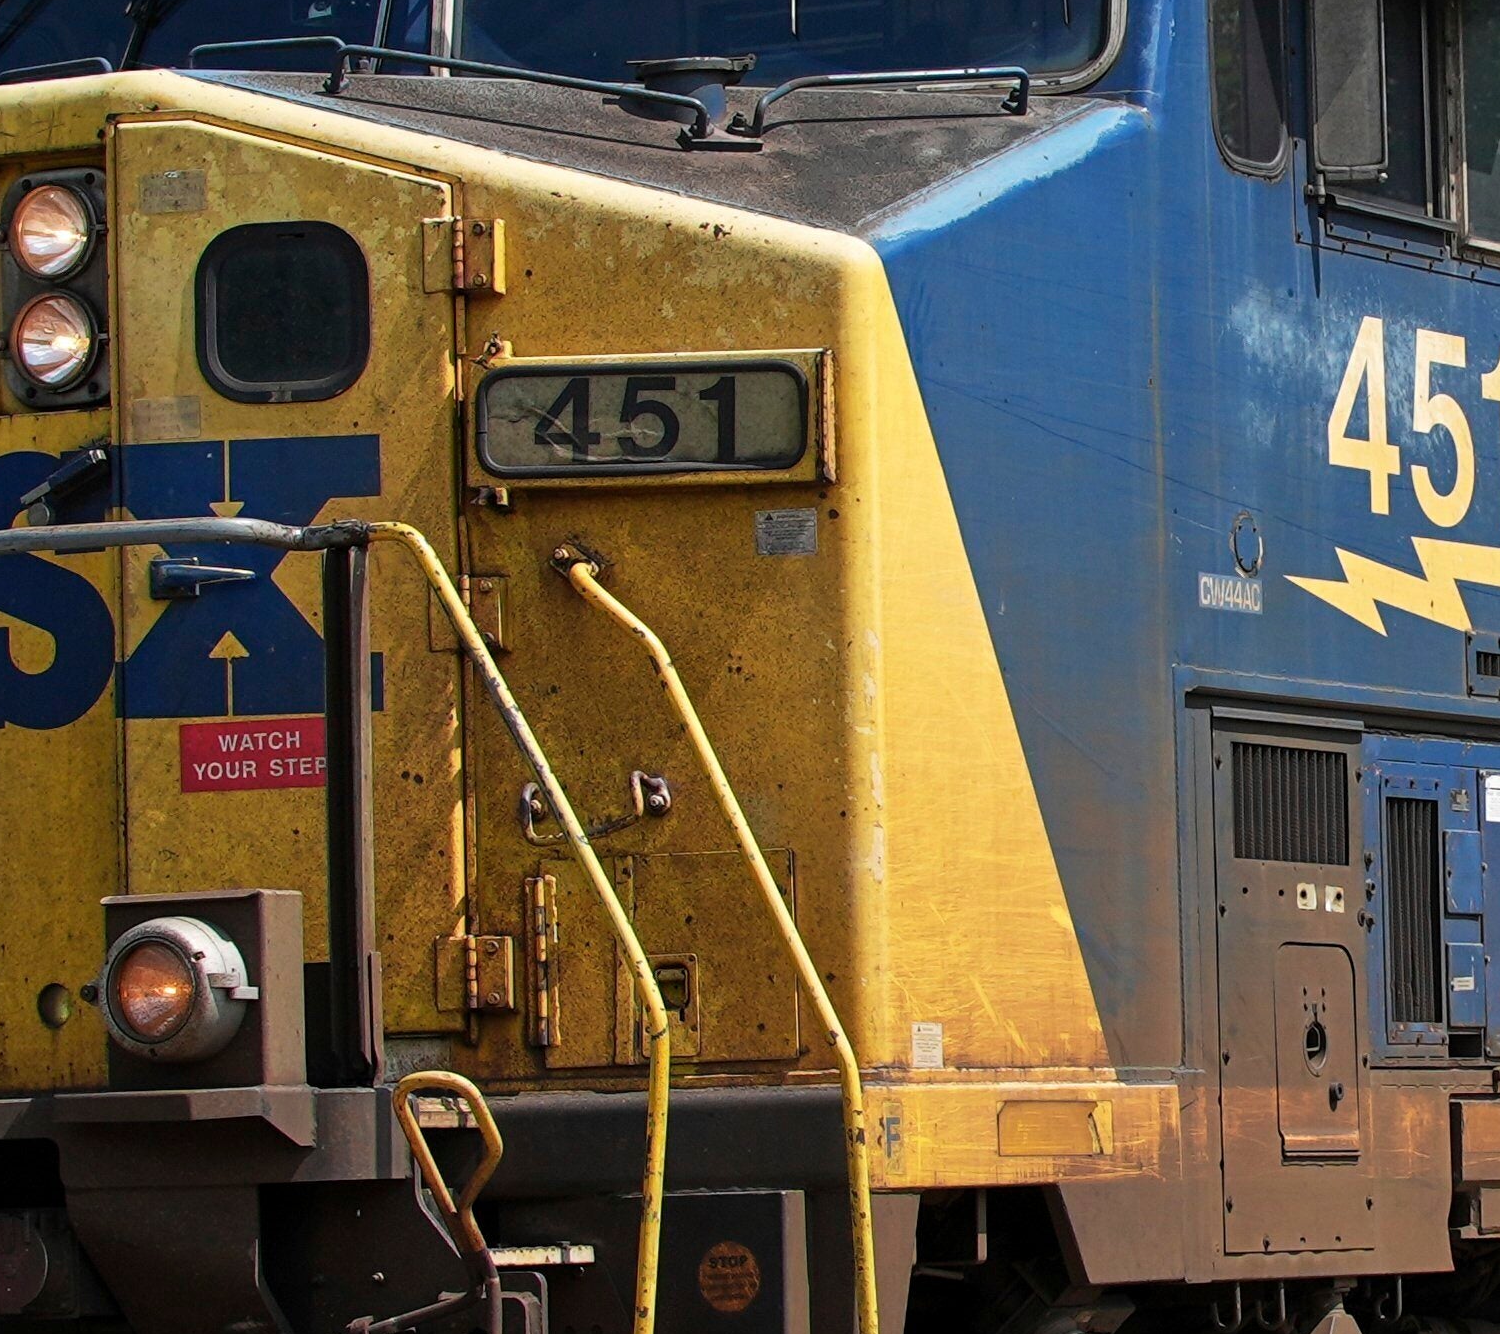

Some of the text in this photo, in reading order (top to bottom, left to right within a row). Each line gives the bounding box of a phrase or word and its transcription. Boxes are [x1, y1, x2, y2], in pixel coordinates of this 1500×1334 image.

[534, 374, 738, 464] 451
[1200, 575, 1261, 612] CW44AC
[217, 729, 302, 754] WATCH
[191, 757, 259, 782] YOUR
[884, 1114, 902, 1157] F
[708, 1254, 748, 1268] STOP
